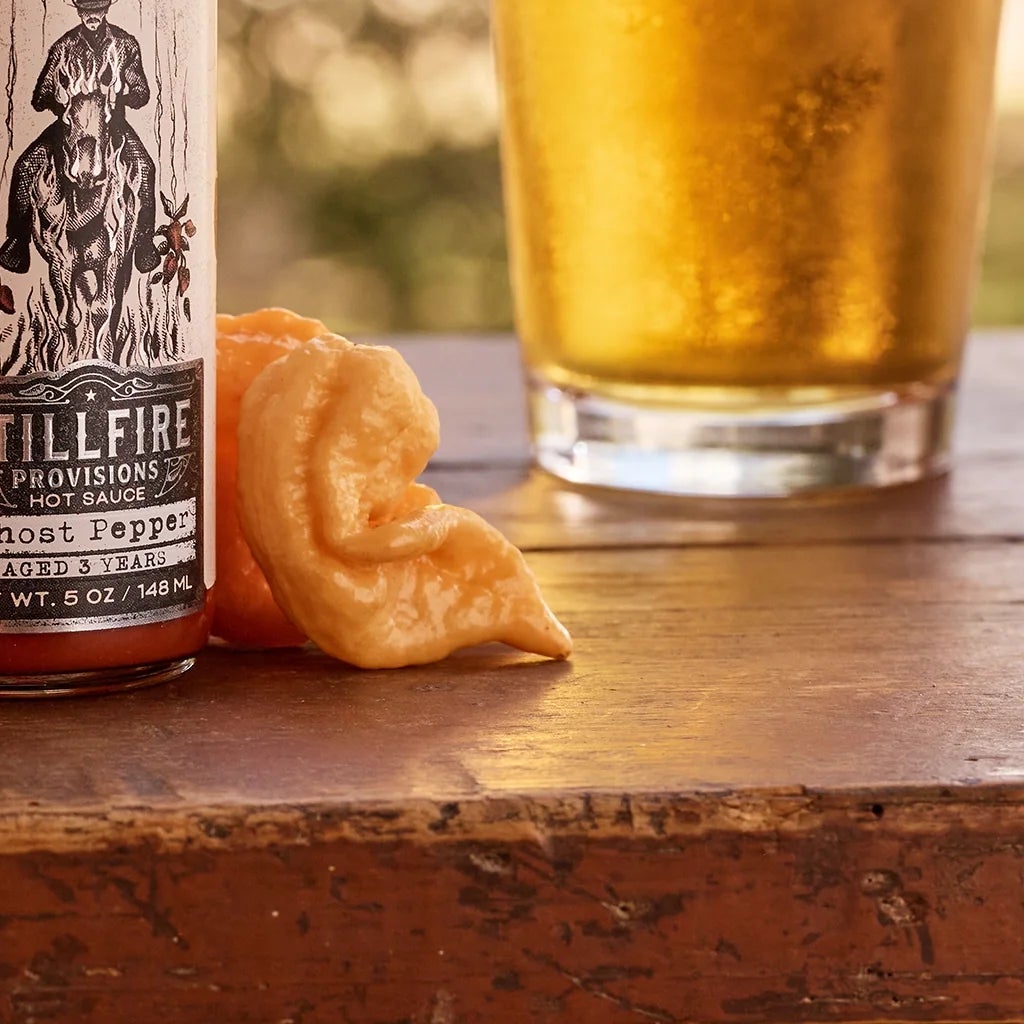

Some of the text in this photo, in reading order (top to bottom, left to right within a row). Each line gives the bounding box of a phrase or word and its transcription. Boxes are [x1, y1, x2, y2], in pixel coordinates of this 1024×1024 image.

[11, 460, 159, 489] PROVISIONS
[29, 488, 146, 508] HOT SAUCE
[88, 509, 190, 543] Pepper
[2, 551, 167, 577] AGED 3 YEARS
[10, 590, 56, 607] WT.
[63, 590, 79, 606] 5
[86, 587, 115, 604] OZ
[121, 585, 131, 602] /
[137, 580, 170, 599] 148
[173, 575, 193, 592] ML
